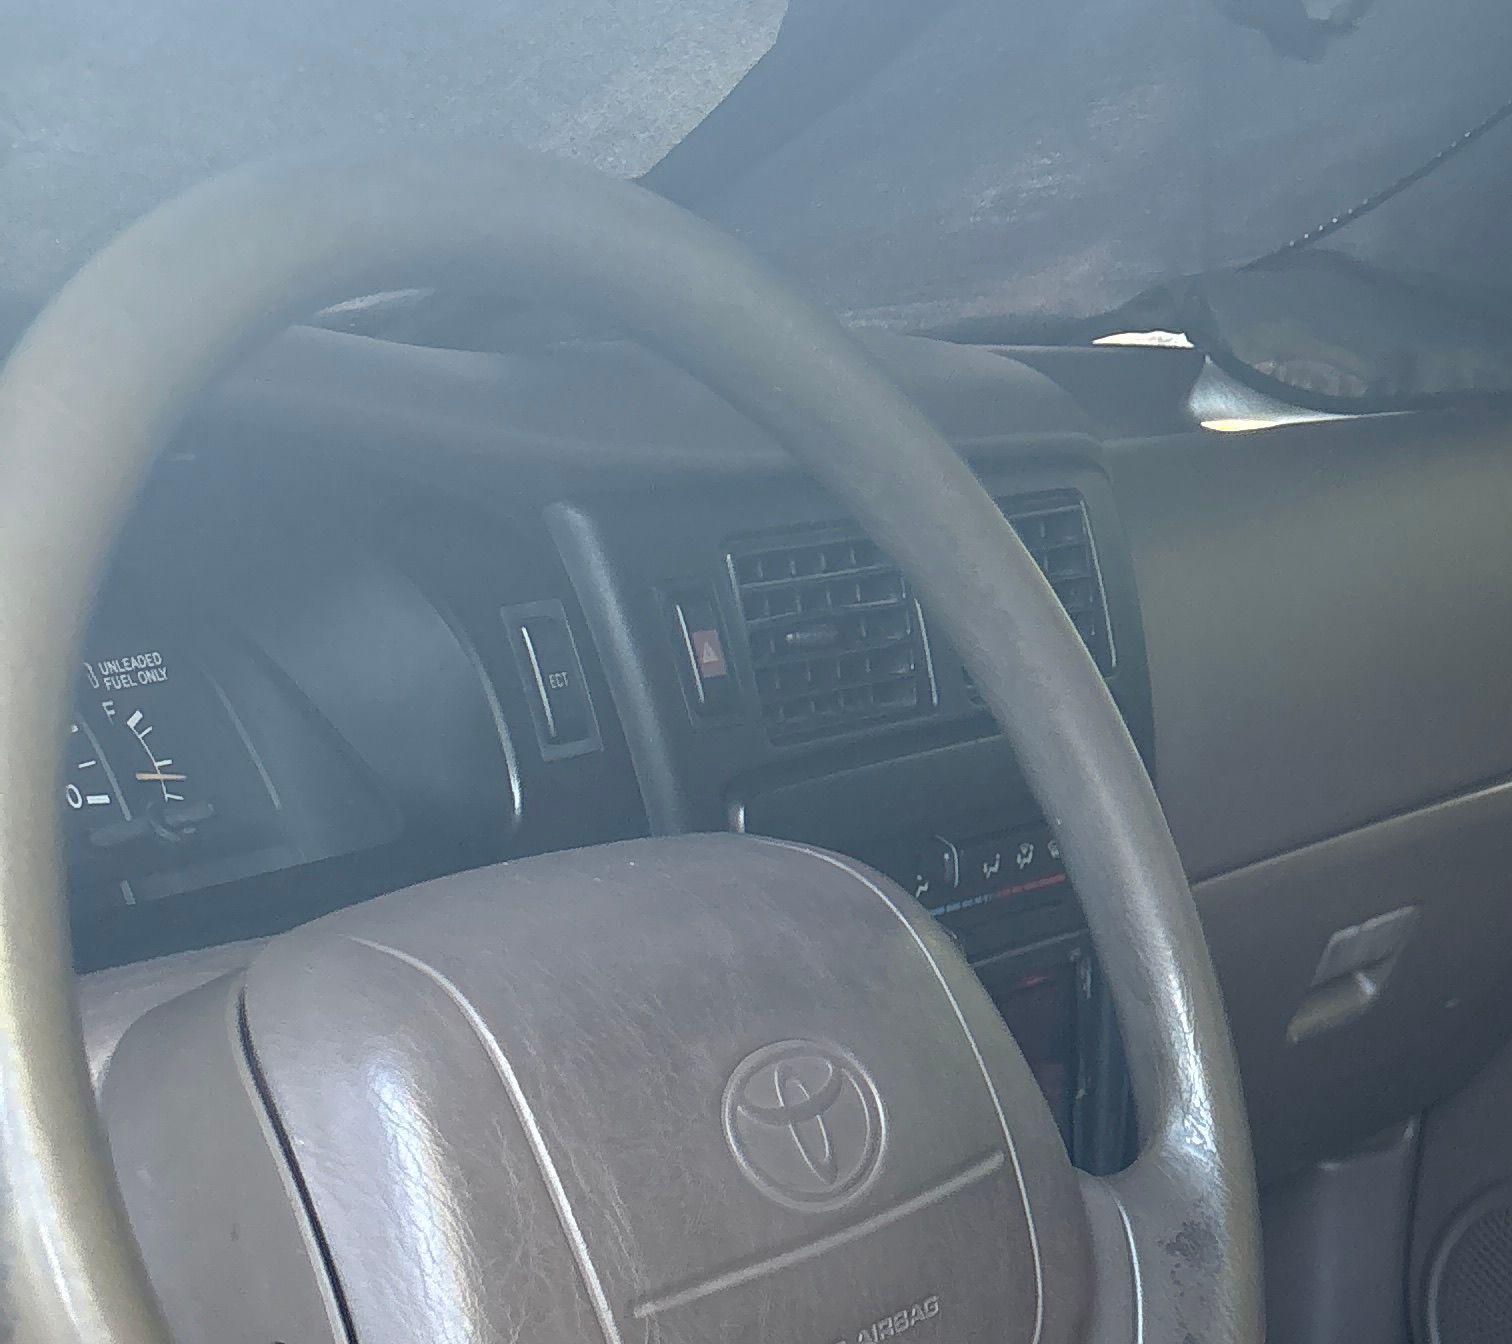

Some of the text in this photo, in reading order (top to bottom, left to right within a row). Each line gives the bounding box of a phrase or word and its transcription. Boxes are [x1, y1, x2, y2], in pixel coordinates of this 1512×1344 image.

[98, 652, 162, 676] UNLEADED
[103, 666, 168, 691] FUEL ONLY
[548, 671, 569, 689] ECT
